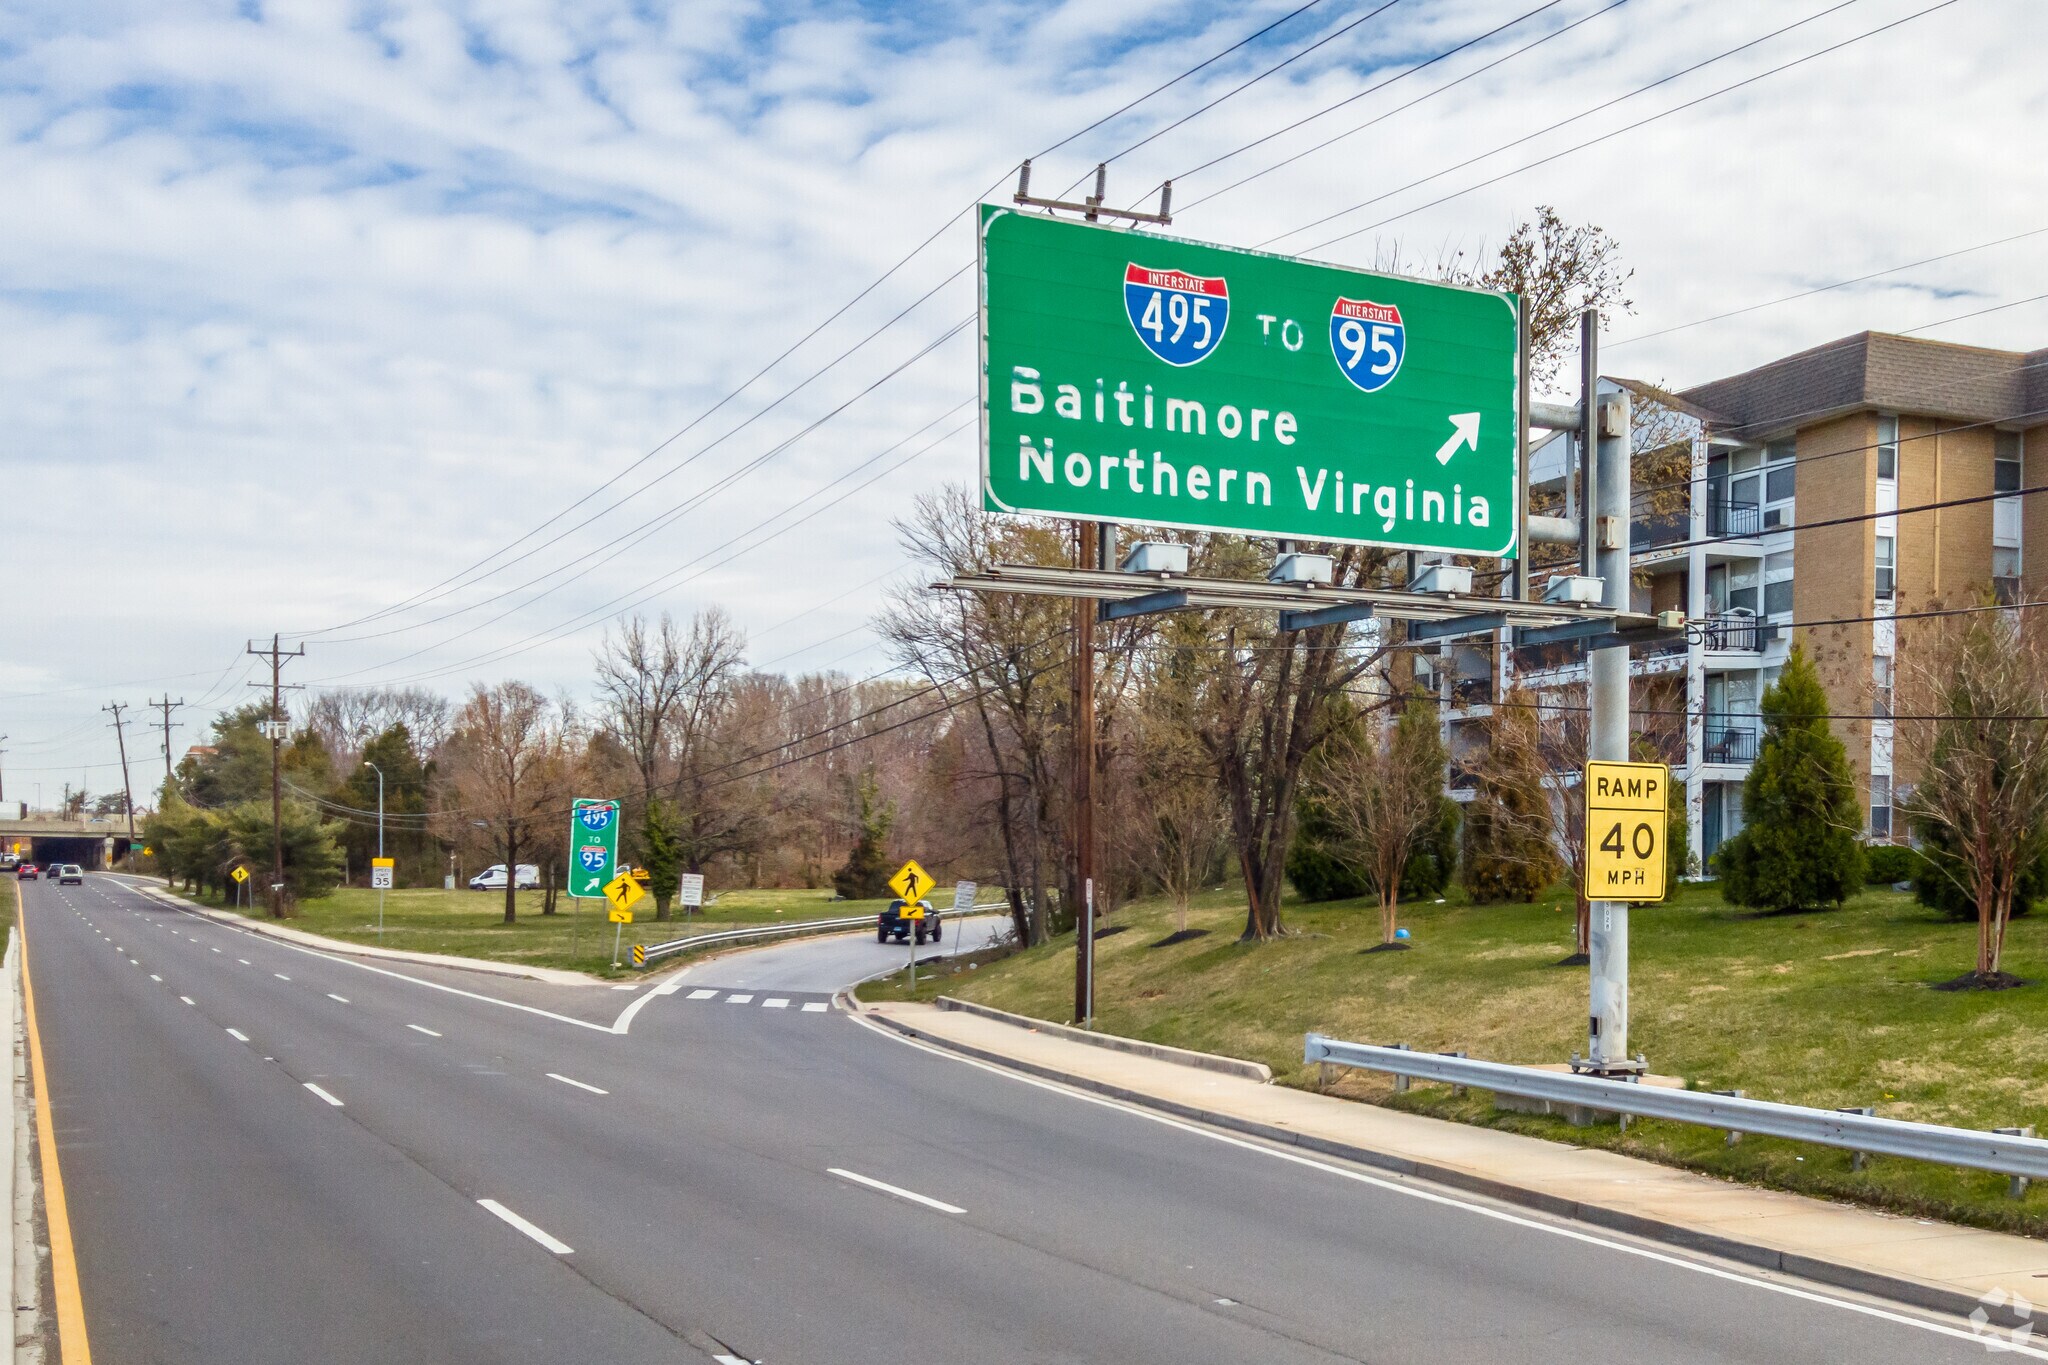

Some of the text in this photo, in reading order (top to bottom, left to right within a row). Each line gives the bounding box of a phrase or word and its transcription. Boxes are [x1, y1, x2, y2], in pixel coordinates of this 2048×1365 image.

[1148, 272, 1206, 293] INTERSTATE
[1342, 303, 1393, 322] INTERSTATE
[1141, 291, 1398, 376] 495 TO 95
[1019, 435, 1491, 534] Northern Virginia
[1597, 777, 1658, 799] RAMP
[583, 810, 608, 827] 495
[588, 835, 601, 844] TO
[1600, 822, 1655, 860] 40
[582, 852, 605, 868] 95
[375, 877, 390, 886] 35
[1607, 870, 1645, 885] MPH
